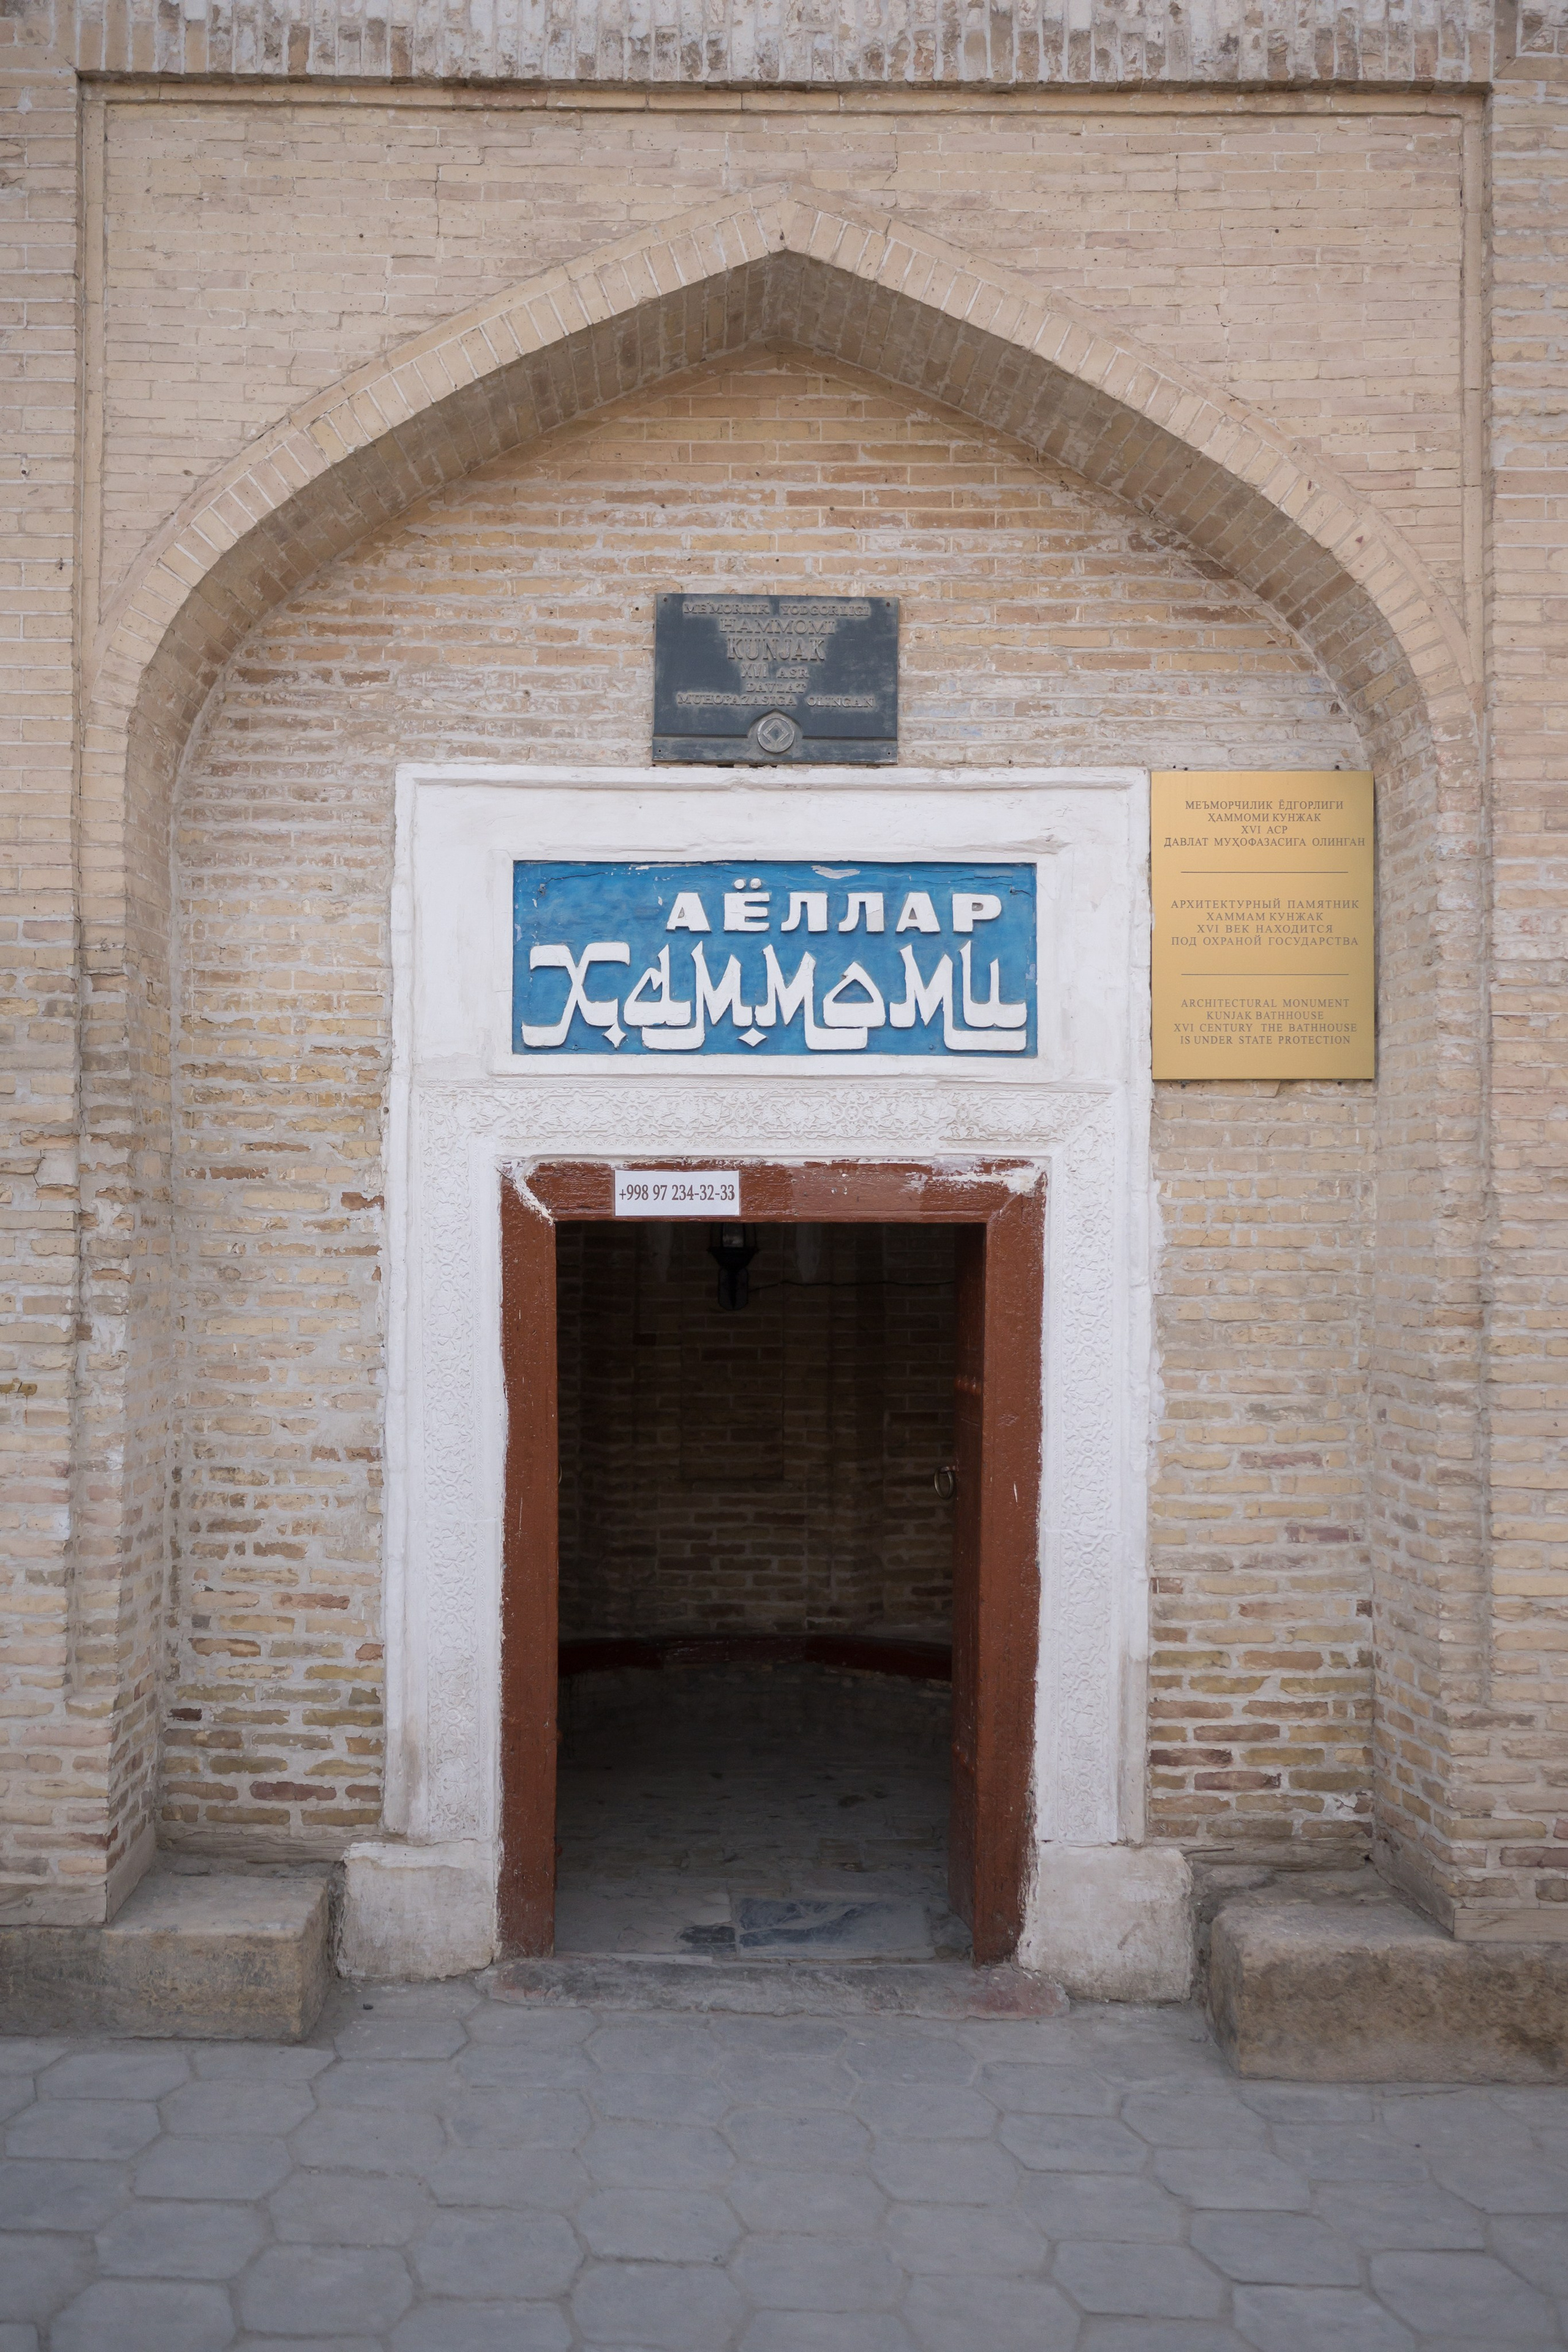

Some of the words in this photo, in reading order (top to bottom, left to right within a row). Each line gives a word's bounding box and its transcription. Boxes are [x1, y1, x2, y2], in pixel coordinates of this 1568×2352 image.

[781, 604, 869, 616] YODGORLIGI
[720, 618, 835, 635] HAMMOMI
[728, 638, 824, 660] KUNJAK
[741, 663, 769, 678] XVI
[777, 667, 809, 679] ASR
[746, 682, 806, 693] DAVLAT
[807, 696, 874, 708] OLINGAN
[1185, 801, 1273, 810] МЕЪМОРЧИЛИК
[1278, 799, 1343, 810] ЁДГОРЛИГИ
[1273, 813, 1321, 822] КУНЖАК
[1267, 825, 1287, 834] АСР
[1164, 837, 1208, 848] ДАВЛАТ
[1312, 837, 1365, 846] ОЛИНГАН
[666, 878, 1002, 933] АЁЛЛАР
[1170, 898, 1281, 909] АРХИТЕКТУРНЫЙ
[1287, 899, 1359, 909] ПАМЯТНИК
[1206, 912, 1265, 921] ХАММАМ
[1270, 912, 1323, 921] КУНЖАК
[1226, 924, 1249, 933] ВЕК
[1256, 924, 1332, 935] НАХОДИТСЯ
[1171, 937, 1197, 947] ПОД
[1203, 935, 1261, 946] ОХРАНОЙ
[1268, 937, 1359, 947] ГОСУДАРСТВА
[1181, 998, 1277, 1008] ARCHITECTURAL
[1283, 998, 1349, 1008] MONUMENT
[1207, 1011, 1252, 1020] KUNJAK
[1256, 1011, 1324, 1020] BATHHOUSE
[1174, 1023, 1193, 1032] XVI
[1199, 1023, 1253, 1032] CENTURY
[1261, 1023, 1283, 1032] THE
[1289, 1023, 1357, 1032] BATHHOUSE
[1180, 1035, 1191, 1044] IS
[1194, 1035, 1233, 1044] UNDER
[1238, 1035, 1272, 1044] STATE
[1278, 1035, 1350, 1044] PROTECTION
[619, 1184, 649, 1200] +998
[652, 1184, 668, 1200] 97
[671, 1184, 735, 1200] 234-32-33
